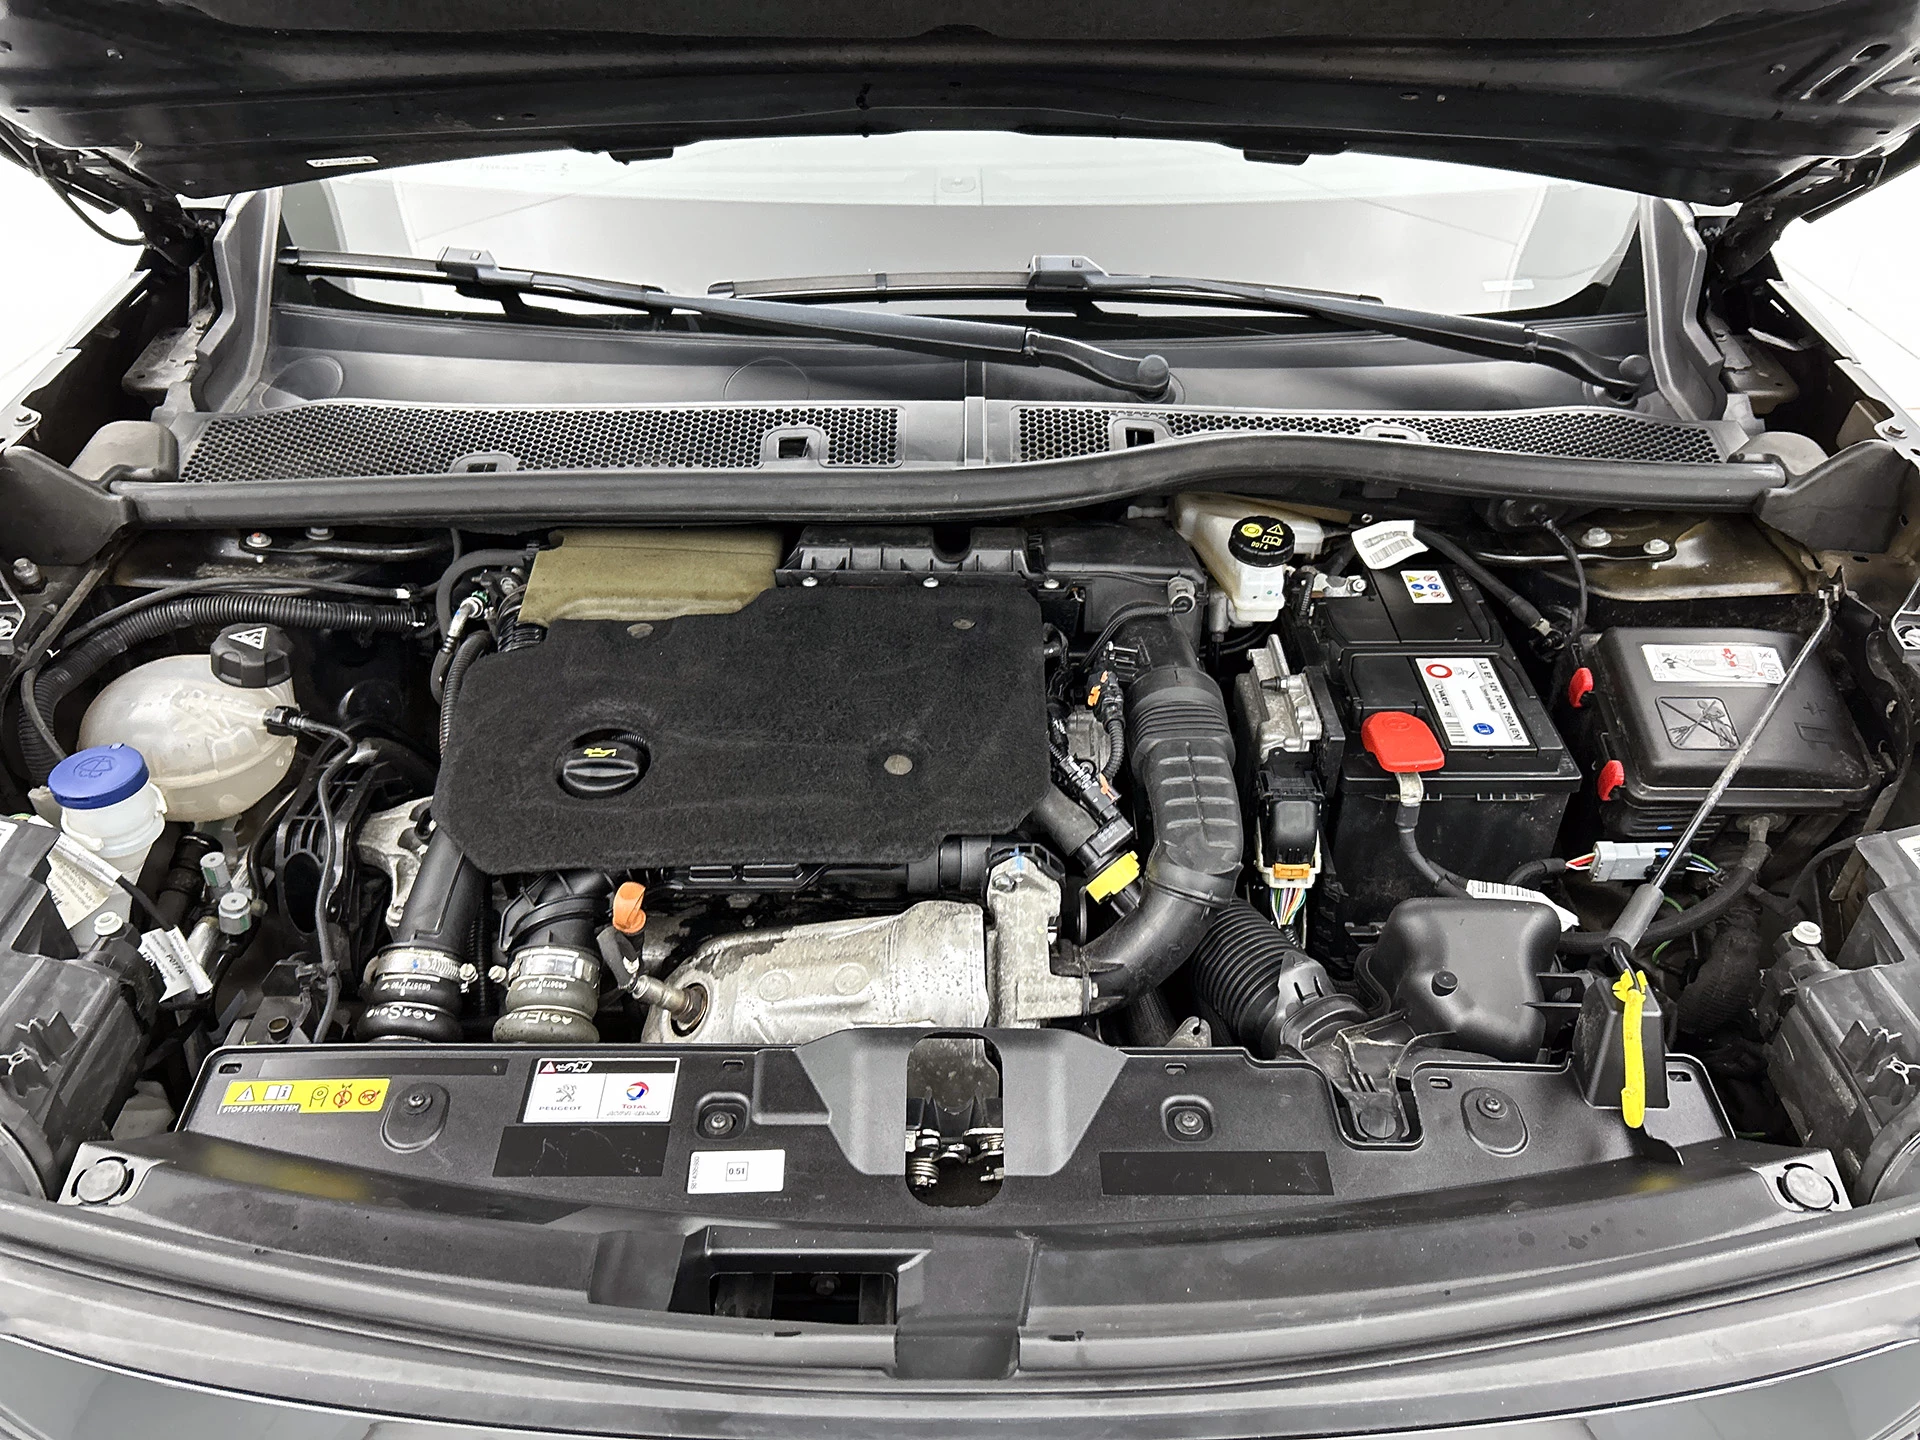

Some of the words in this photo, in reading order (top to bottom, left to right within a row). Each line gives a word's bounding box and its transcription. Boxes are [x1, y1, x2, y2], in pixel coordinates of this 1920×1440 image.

[1250, 541, 1263, 549] DOT
[222, 1105, 242, 1113] STOP
[248, 1105, 271, 1113] START
[271, 1104, 300, 1112] SYSTEM
[728, 1167, 745, 1175] 0.51
